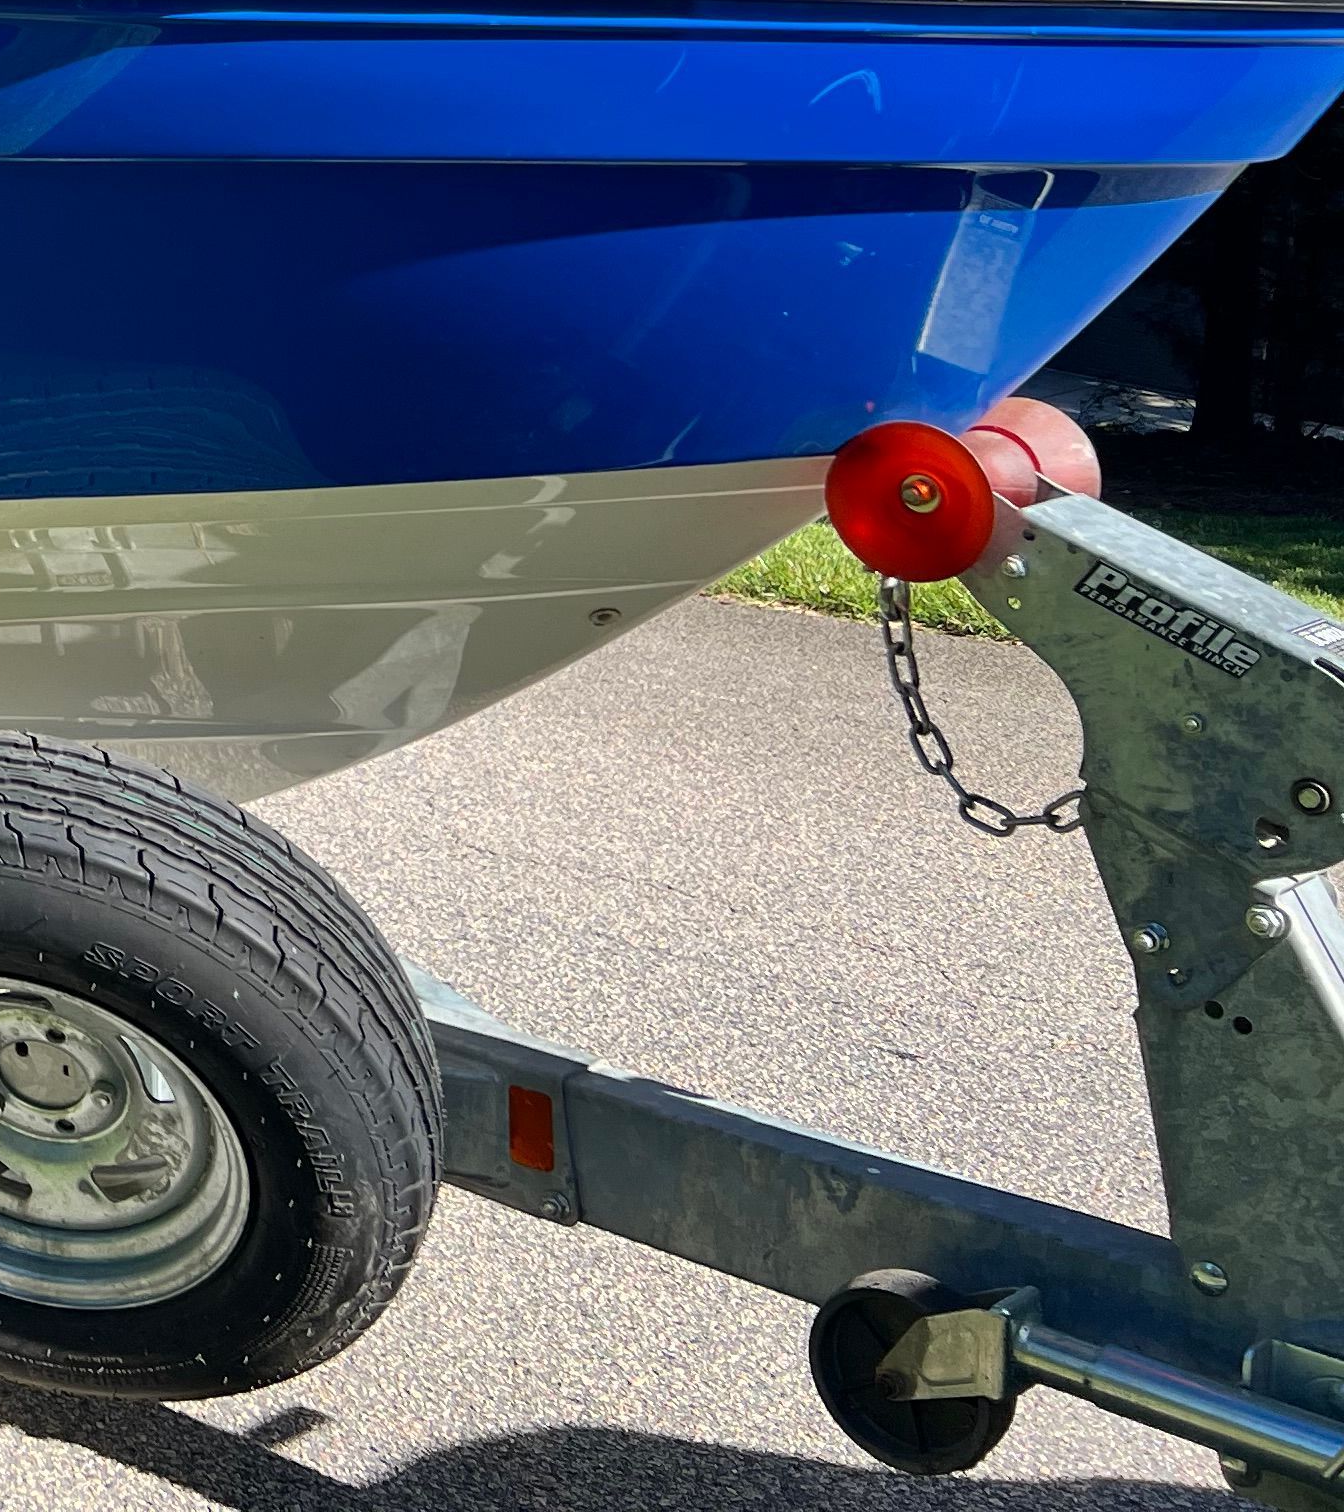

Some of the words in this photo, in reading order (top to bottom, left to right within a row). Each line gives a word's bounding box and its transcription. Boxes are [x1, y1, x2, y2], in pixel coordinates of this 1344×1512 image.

[1079, 586, 1187, 648] PERFORMANCE
[1191, 642, 1245, 677] WINCH
[1082, 563, 1261, 670] Profile
[83, 941, 261, 1049] SPORT
